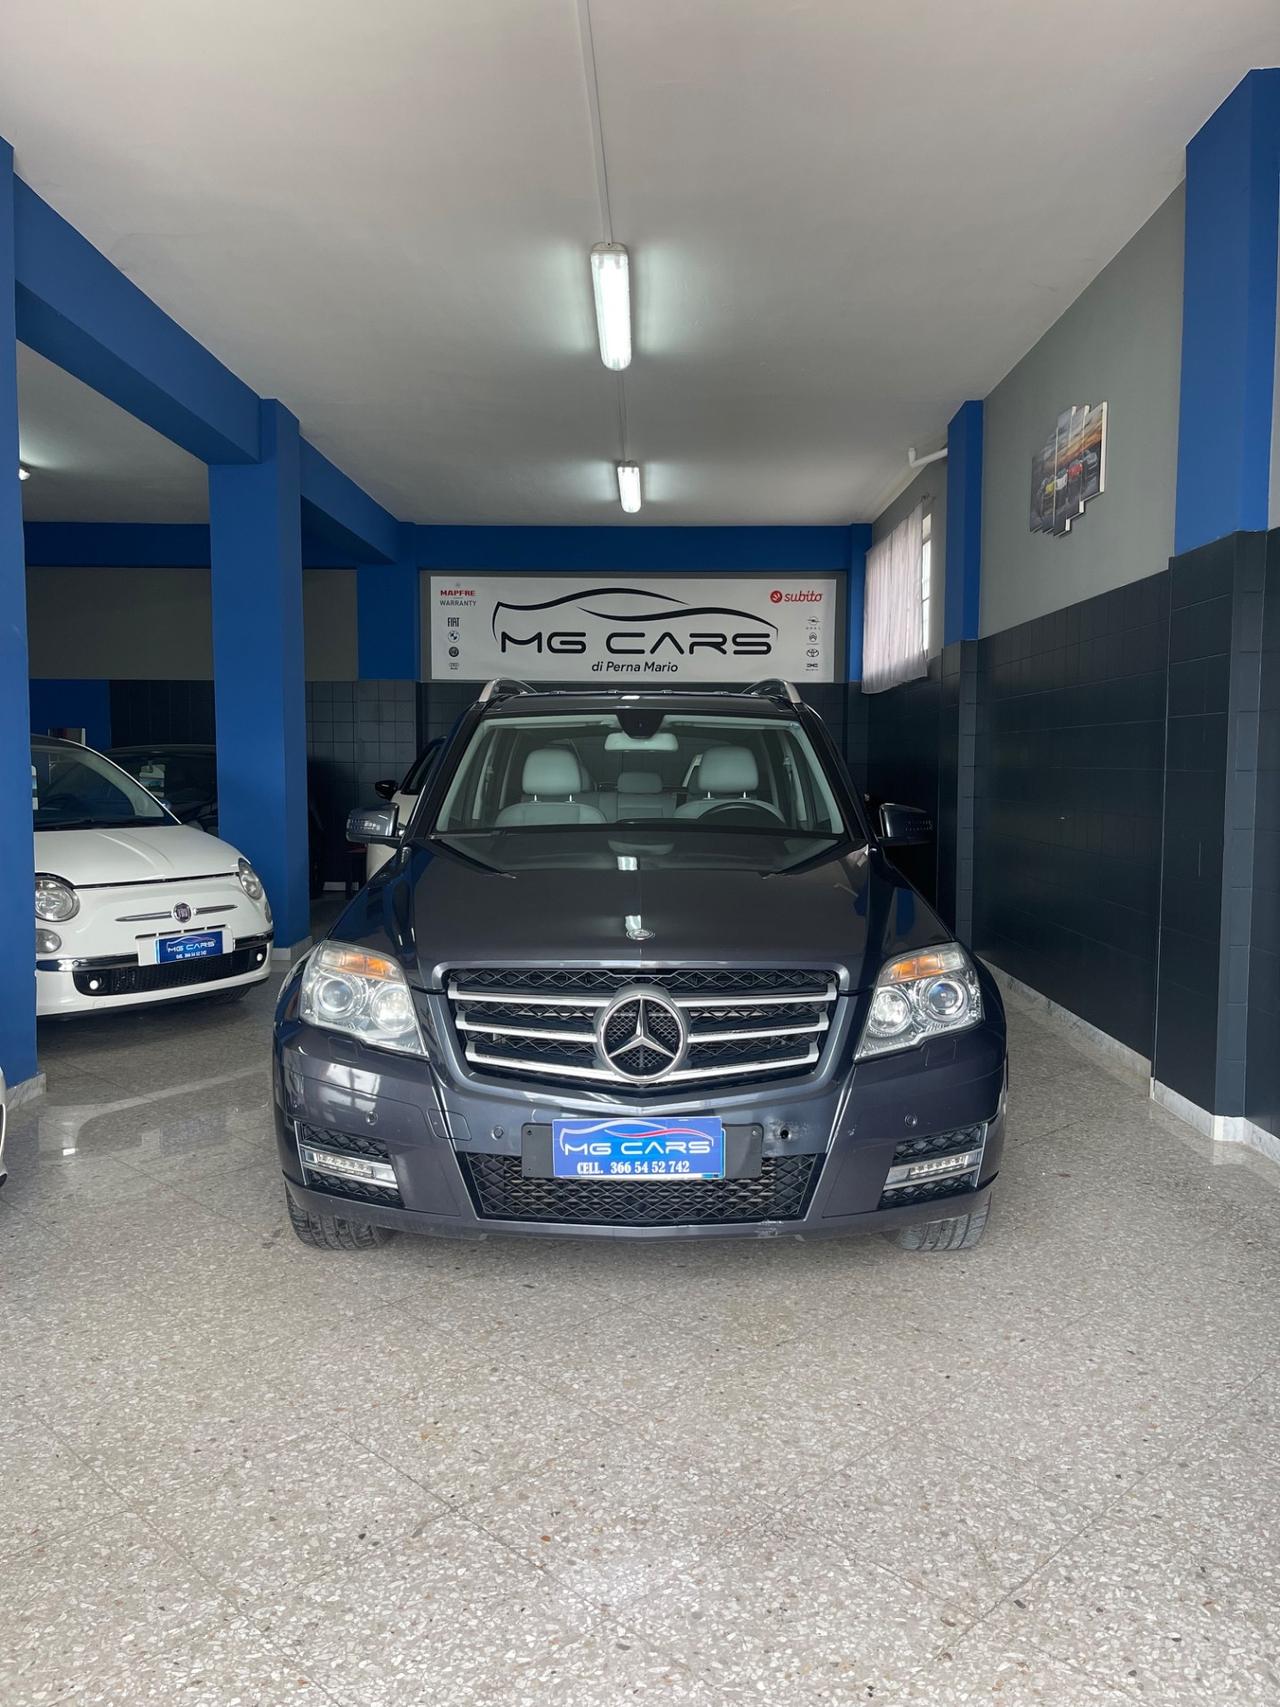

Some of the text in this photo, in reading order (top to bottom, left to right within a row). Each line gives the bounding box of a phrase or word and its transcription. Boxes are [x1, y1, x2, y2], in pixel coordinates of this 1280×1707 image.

[784, 591, 823, 602] subito
[447, 617, 460, 627] FIAT
[501, 631, 772, 655] MG CARS
[591, 661, 679, 673] di Perna Mario
[186, 941, 215, 950] CARS
[565, 1141, 711, 1156] MG CARS
[577, 1160, 690, 1175] CELL. 366 54 52 742
